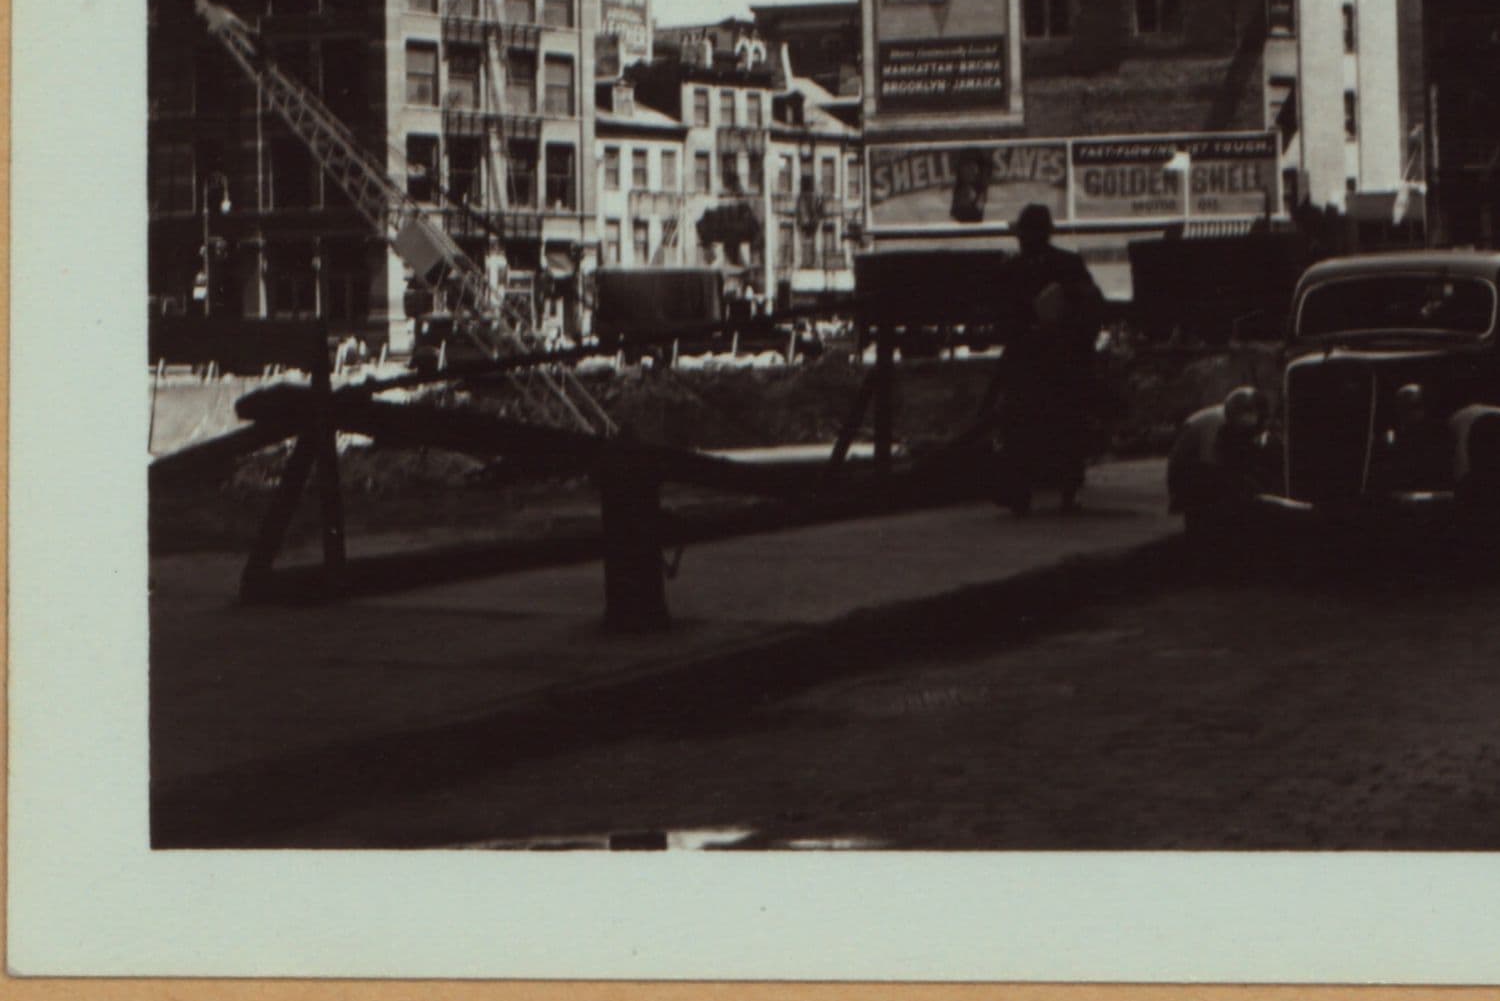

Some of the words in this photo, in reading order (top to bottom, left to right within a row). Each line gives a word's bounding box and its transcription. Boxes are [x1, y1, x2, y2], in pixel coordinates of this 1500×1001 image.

[882, 62, 953, 77] MANHATTAN
[882, 79, 946, 96] BROOKLYN
[953, 77, 1002, 93] JAMAICA
[872, 150, 955, 199] SHELL
[993, 147, 1066, 182] SAVES
[1083, 167, 1179, 198] GOLDEN
[1190, 161, 1261, 195] SHELL
